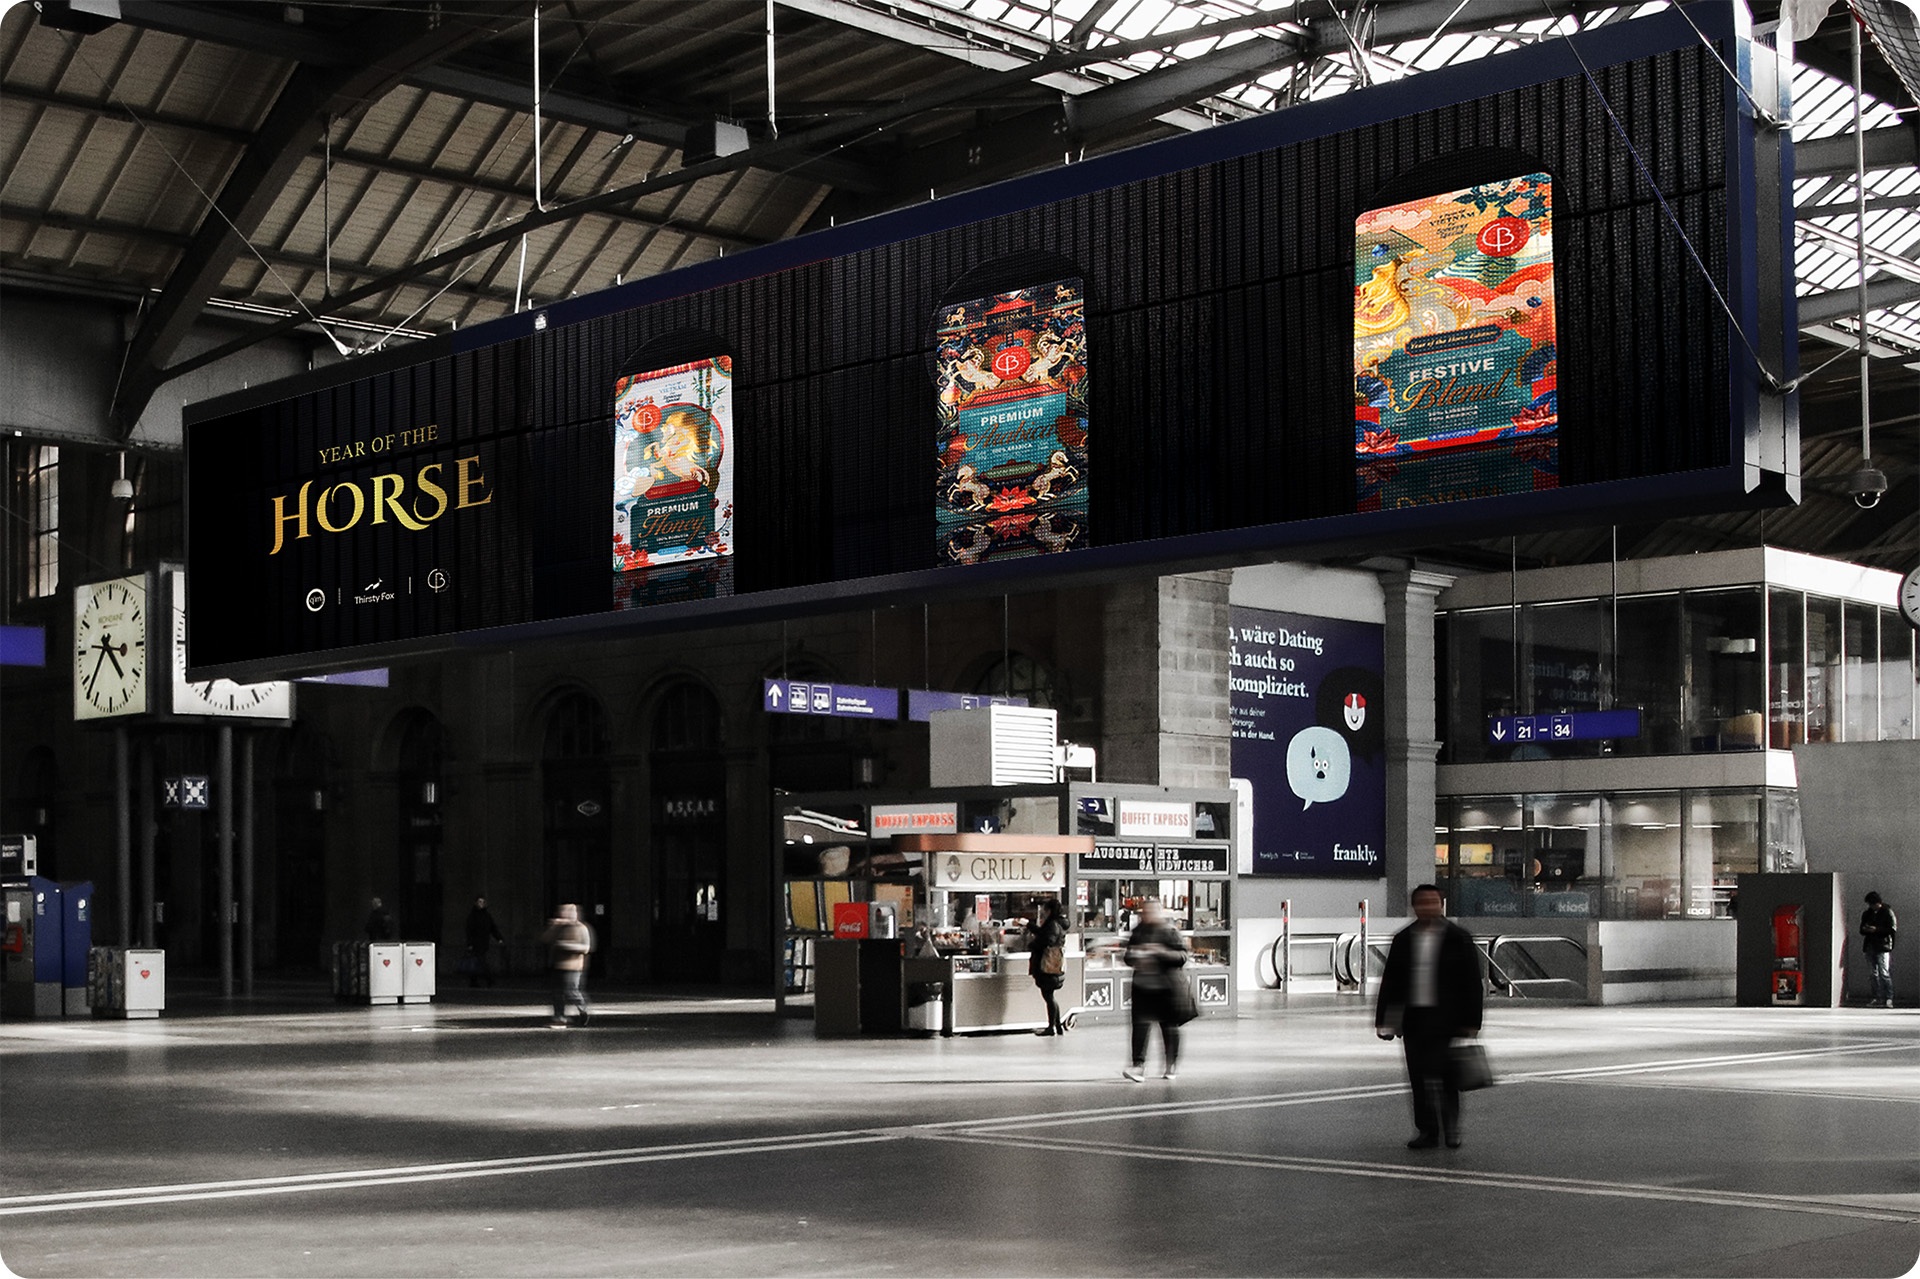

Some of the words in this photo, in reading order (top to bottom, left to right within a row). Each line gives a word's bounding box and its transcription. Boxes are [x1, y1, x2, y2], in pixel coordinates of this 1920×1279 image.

[1429, 211, 1476, 227] VIETNAM
[1409, 357, 1496, 384] FESTIVE
[1394, 368, 1512, 414] Blend
[980, 407, 1044, 427] PREMIUM
[319, 442, 366, 465] YEAR
[371, 434, 396, 453] OF
[399, 424, 439, 447] THE
[964, 420, 1056, 452] Arabica
[269, 455, 494, 555] HORSE
[647, 501, 699, 517] PREMIUM
[638, 510, 707, 545] Honey
[354, 594, 380, 605] Thirsty
[380, 591, 395, 601] Fox
[1241, 625, 1276, 645] wäre
[1279, 628, 1324, 655] Dating
[1244, 650, 1277, 670] auch
[1279, 657, 1295, 672] so
[1229, 670, 1309, 698] kompliziert.
[1518, 726, 1532, 739] 21
[1554, 723, 1570, 738] 34
[875, 815, 909, 828] BUFFET
[912, 812, 955, 827] EXPRESS
[1122, 812, 1150, 825] BUFFET
[1153, 812, 1188, 826] EXPRESS
[1333, 844, 1378, 865] frankly.
[971, 857, 1032, 881] GRILL
